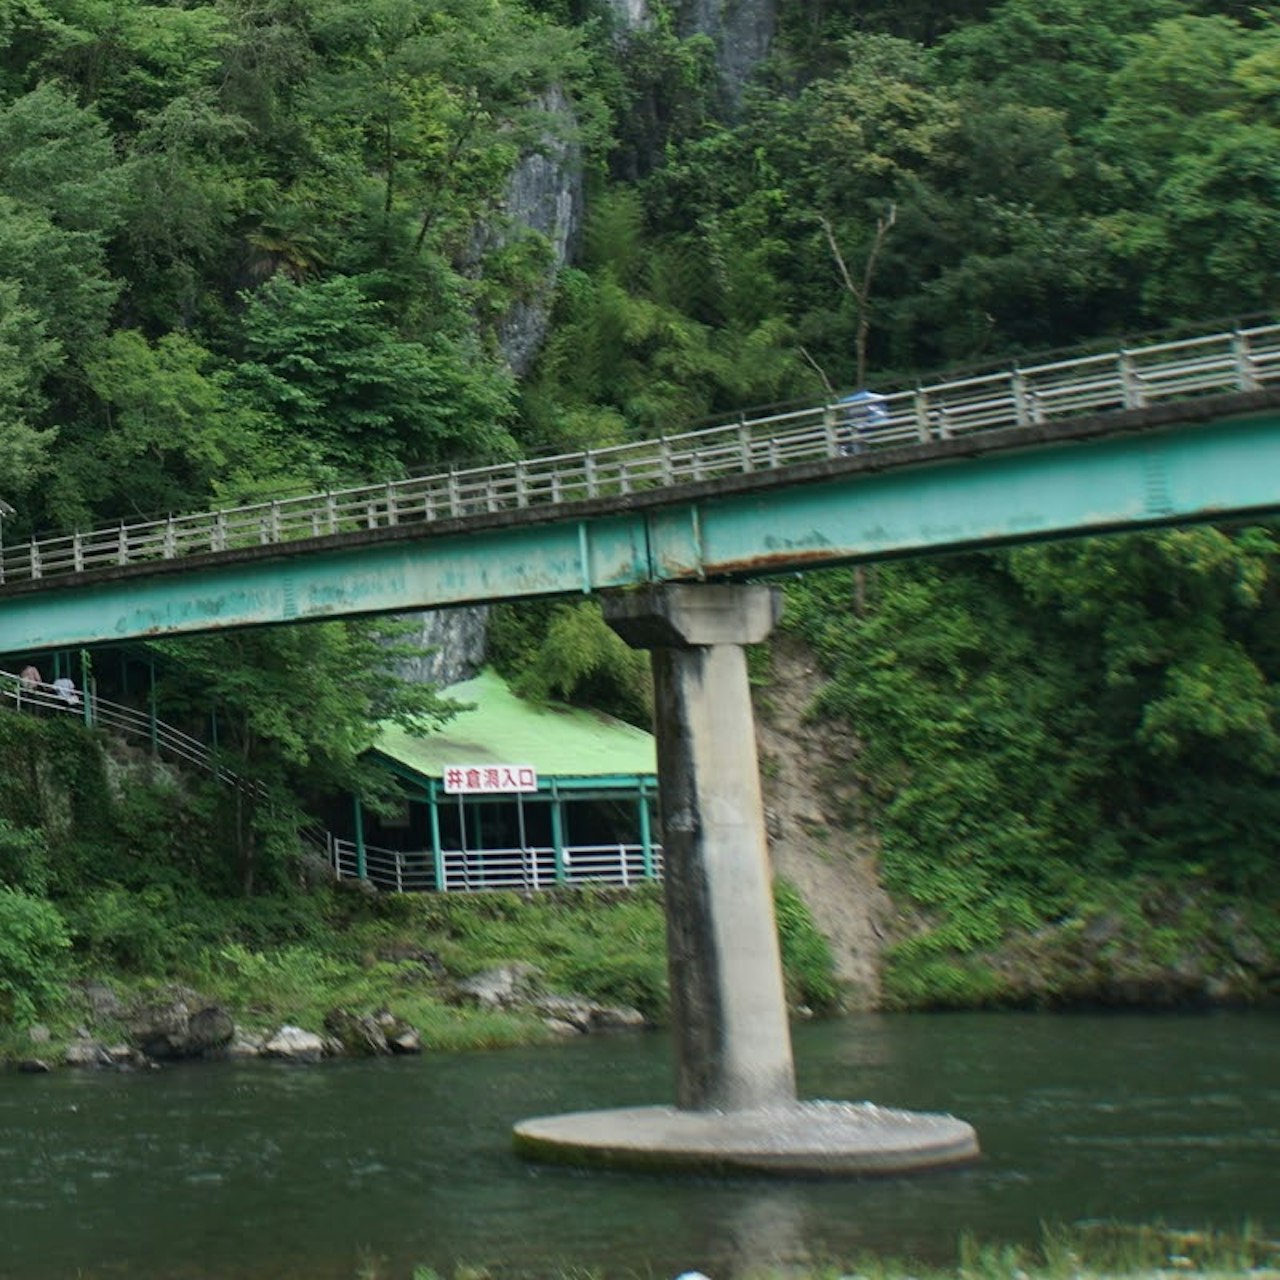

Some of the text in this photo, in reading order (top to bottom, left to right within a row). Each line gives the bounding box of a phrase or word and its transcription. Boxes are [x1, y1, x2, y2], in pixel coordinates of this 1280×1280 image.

[447, 768, 534, 788] 井倉洞入口
